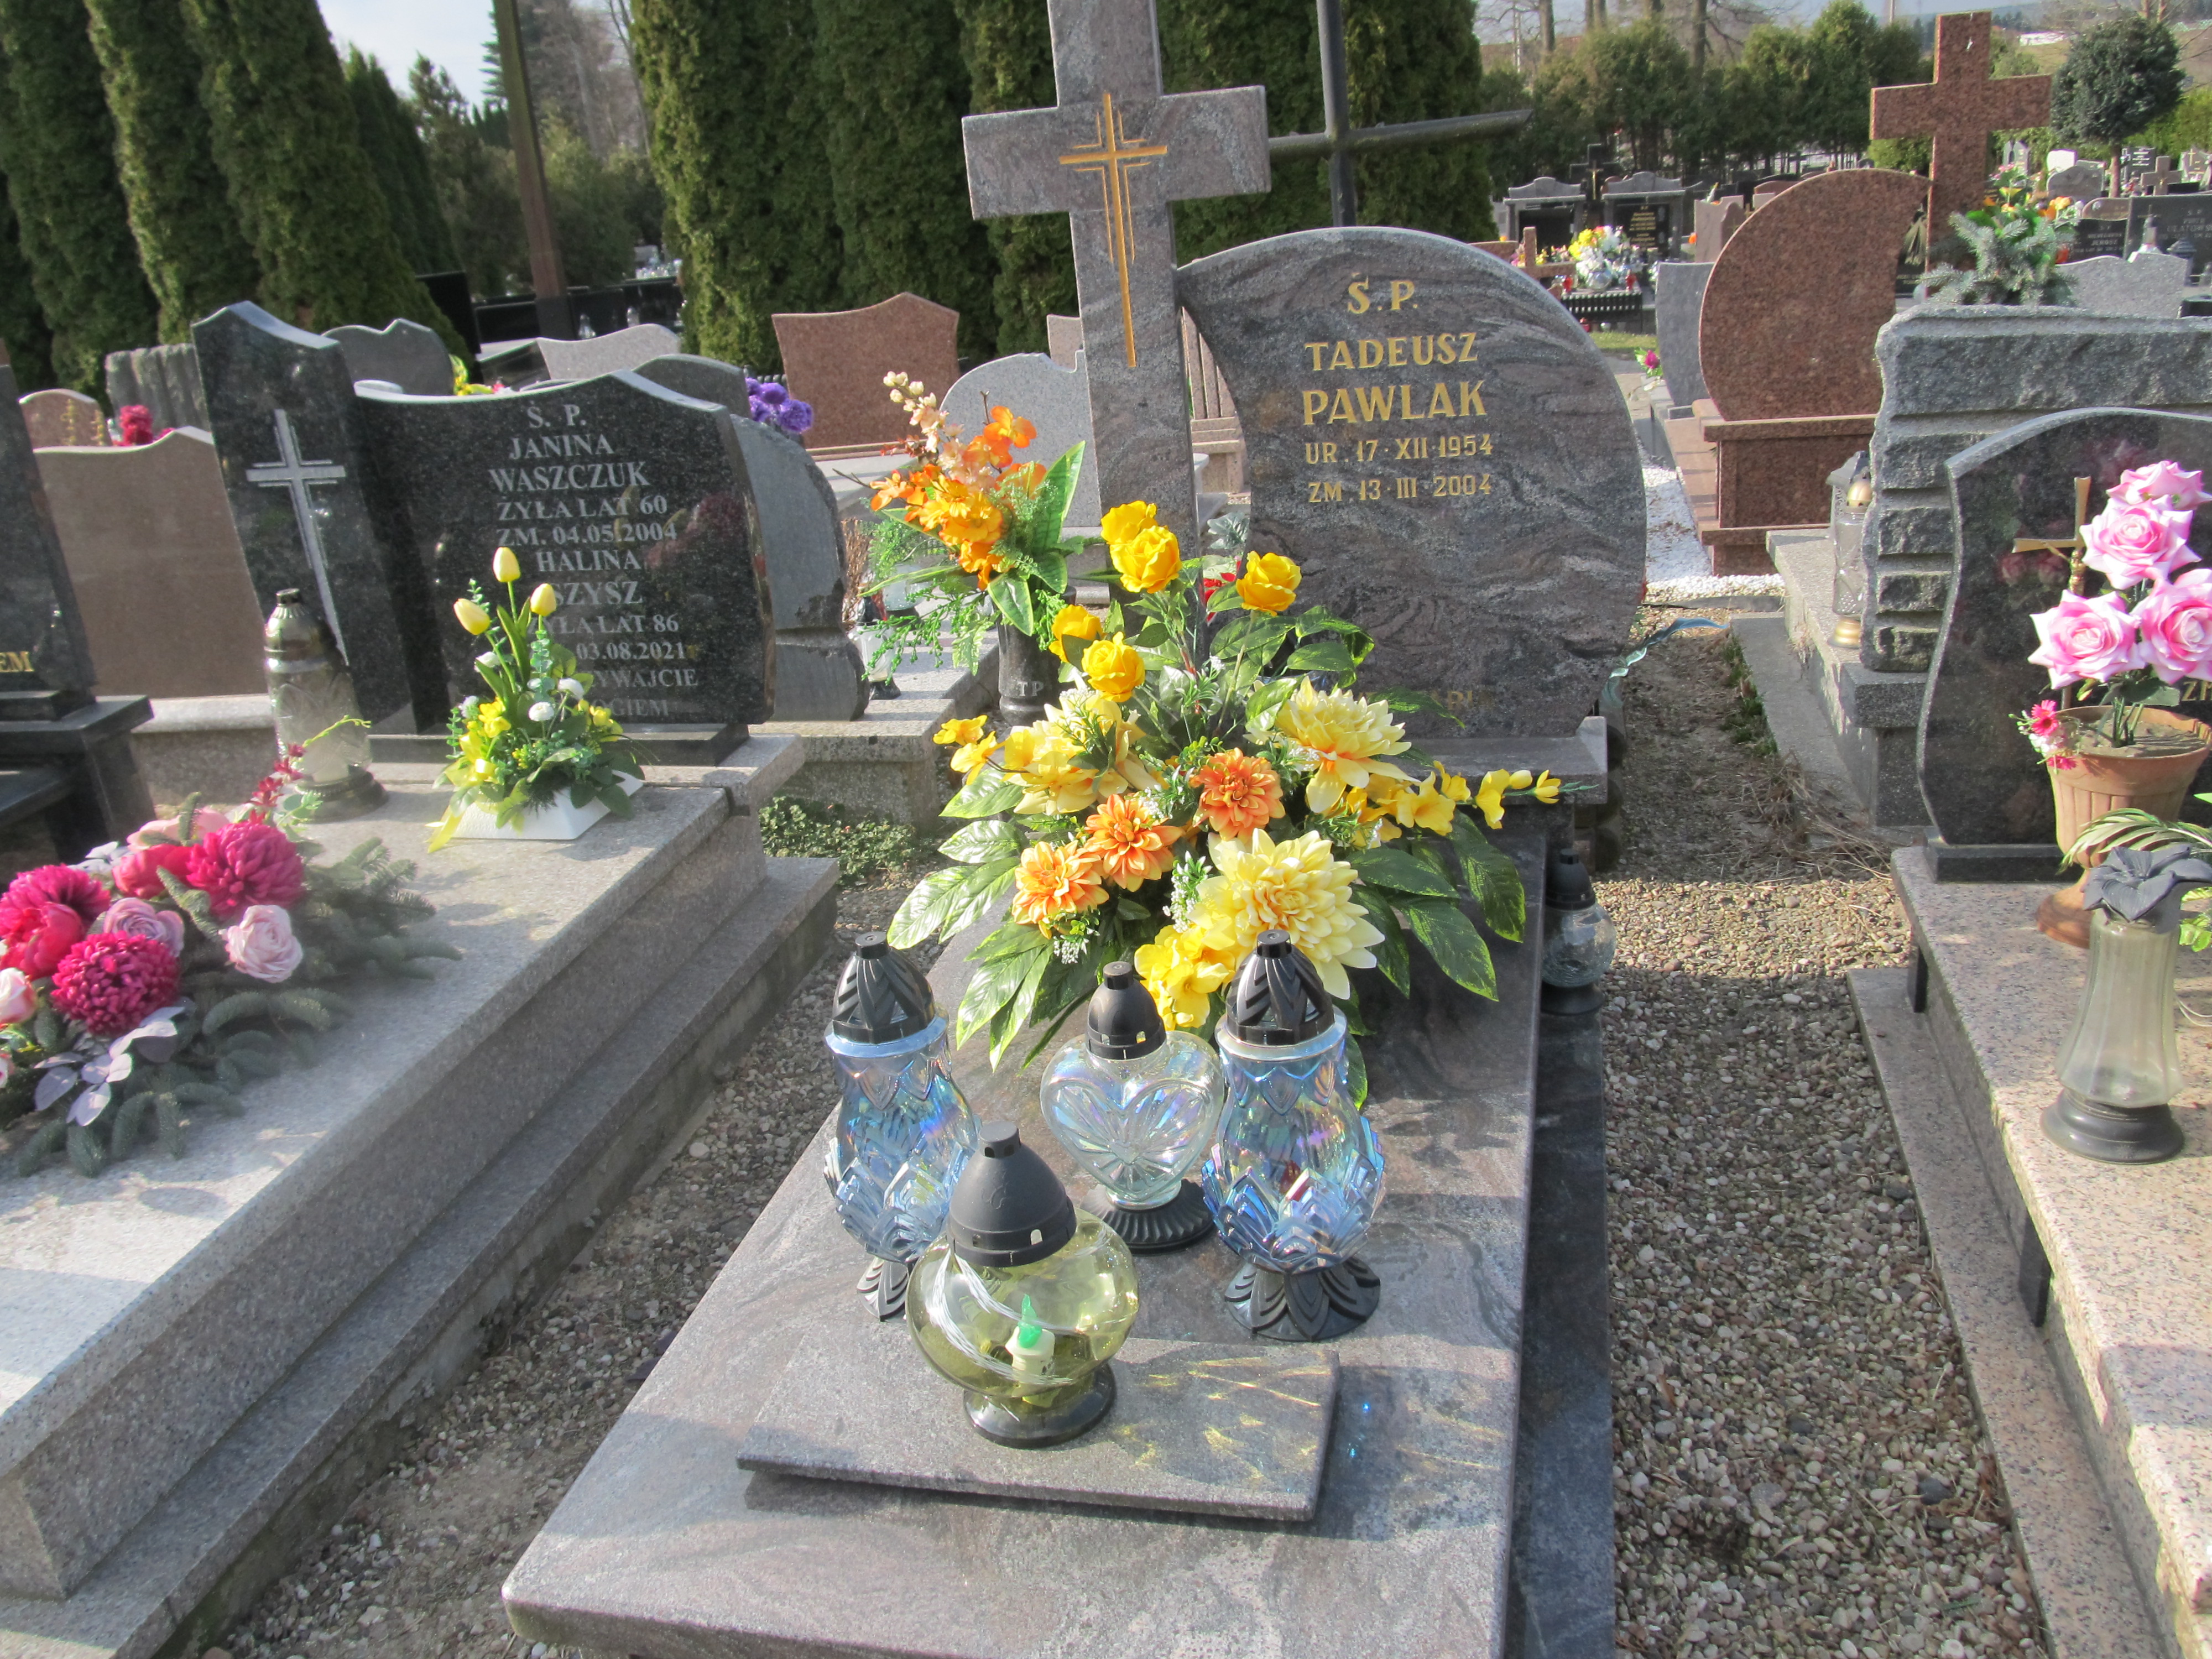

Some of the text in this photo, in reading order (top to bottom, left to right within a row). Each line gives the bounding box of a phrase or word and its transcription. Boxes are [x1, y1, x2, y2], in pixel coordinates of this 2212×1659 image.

[1304, 332, 1478, 371] TADEUSZ
[1302, 379, 1487, 425] PAWLAK
[509, 434, 615, 460] JANINA
[1305, 442, 1349, 465] UR.
[489, 461, 650, 492] WASZCZUK
[576, 497, 629, 517] LAT
[639, 495, 667, 514] 60
[497, 522, 677, 546] ZM. 04.05.2004
[536, 549, 641, 572] HALINA
[597, 615, 646, 634] LAT
[652, 613, 680, 632] 86
[576, 641, 686, 661] 03.08.2021
